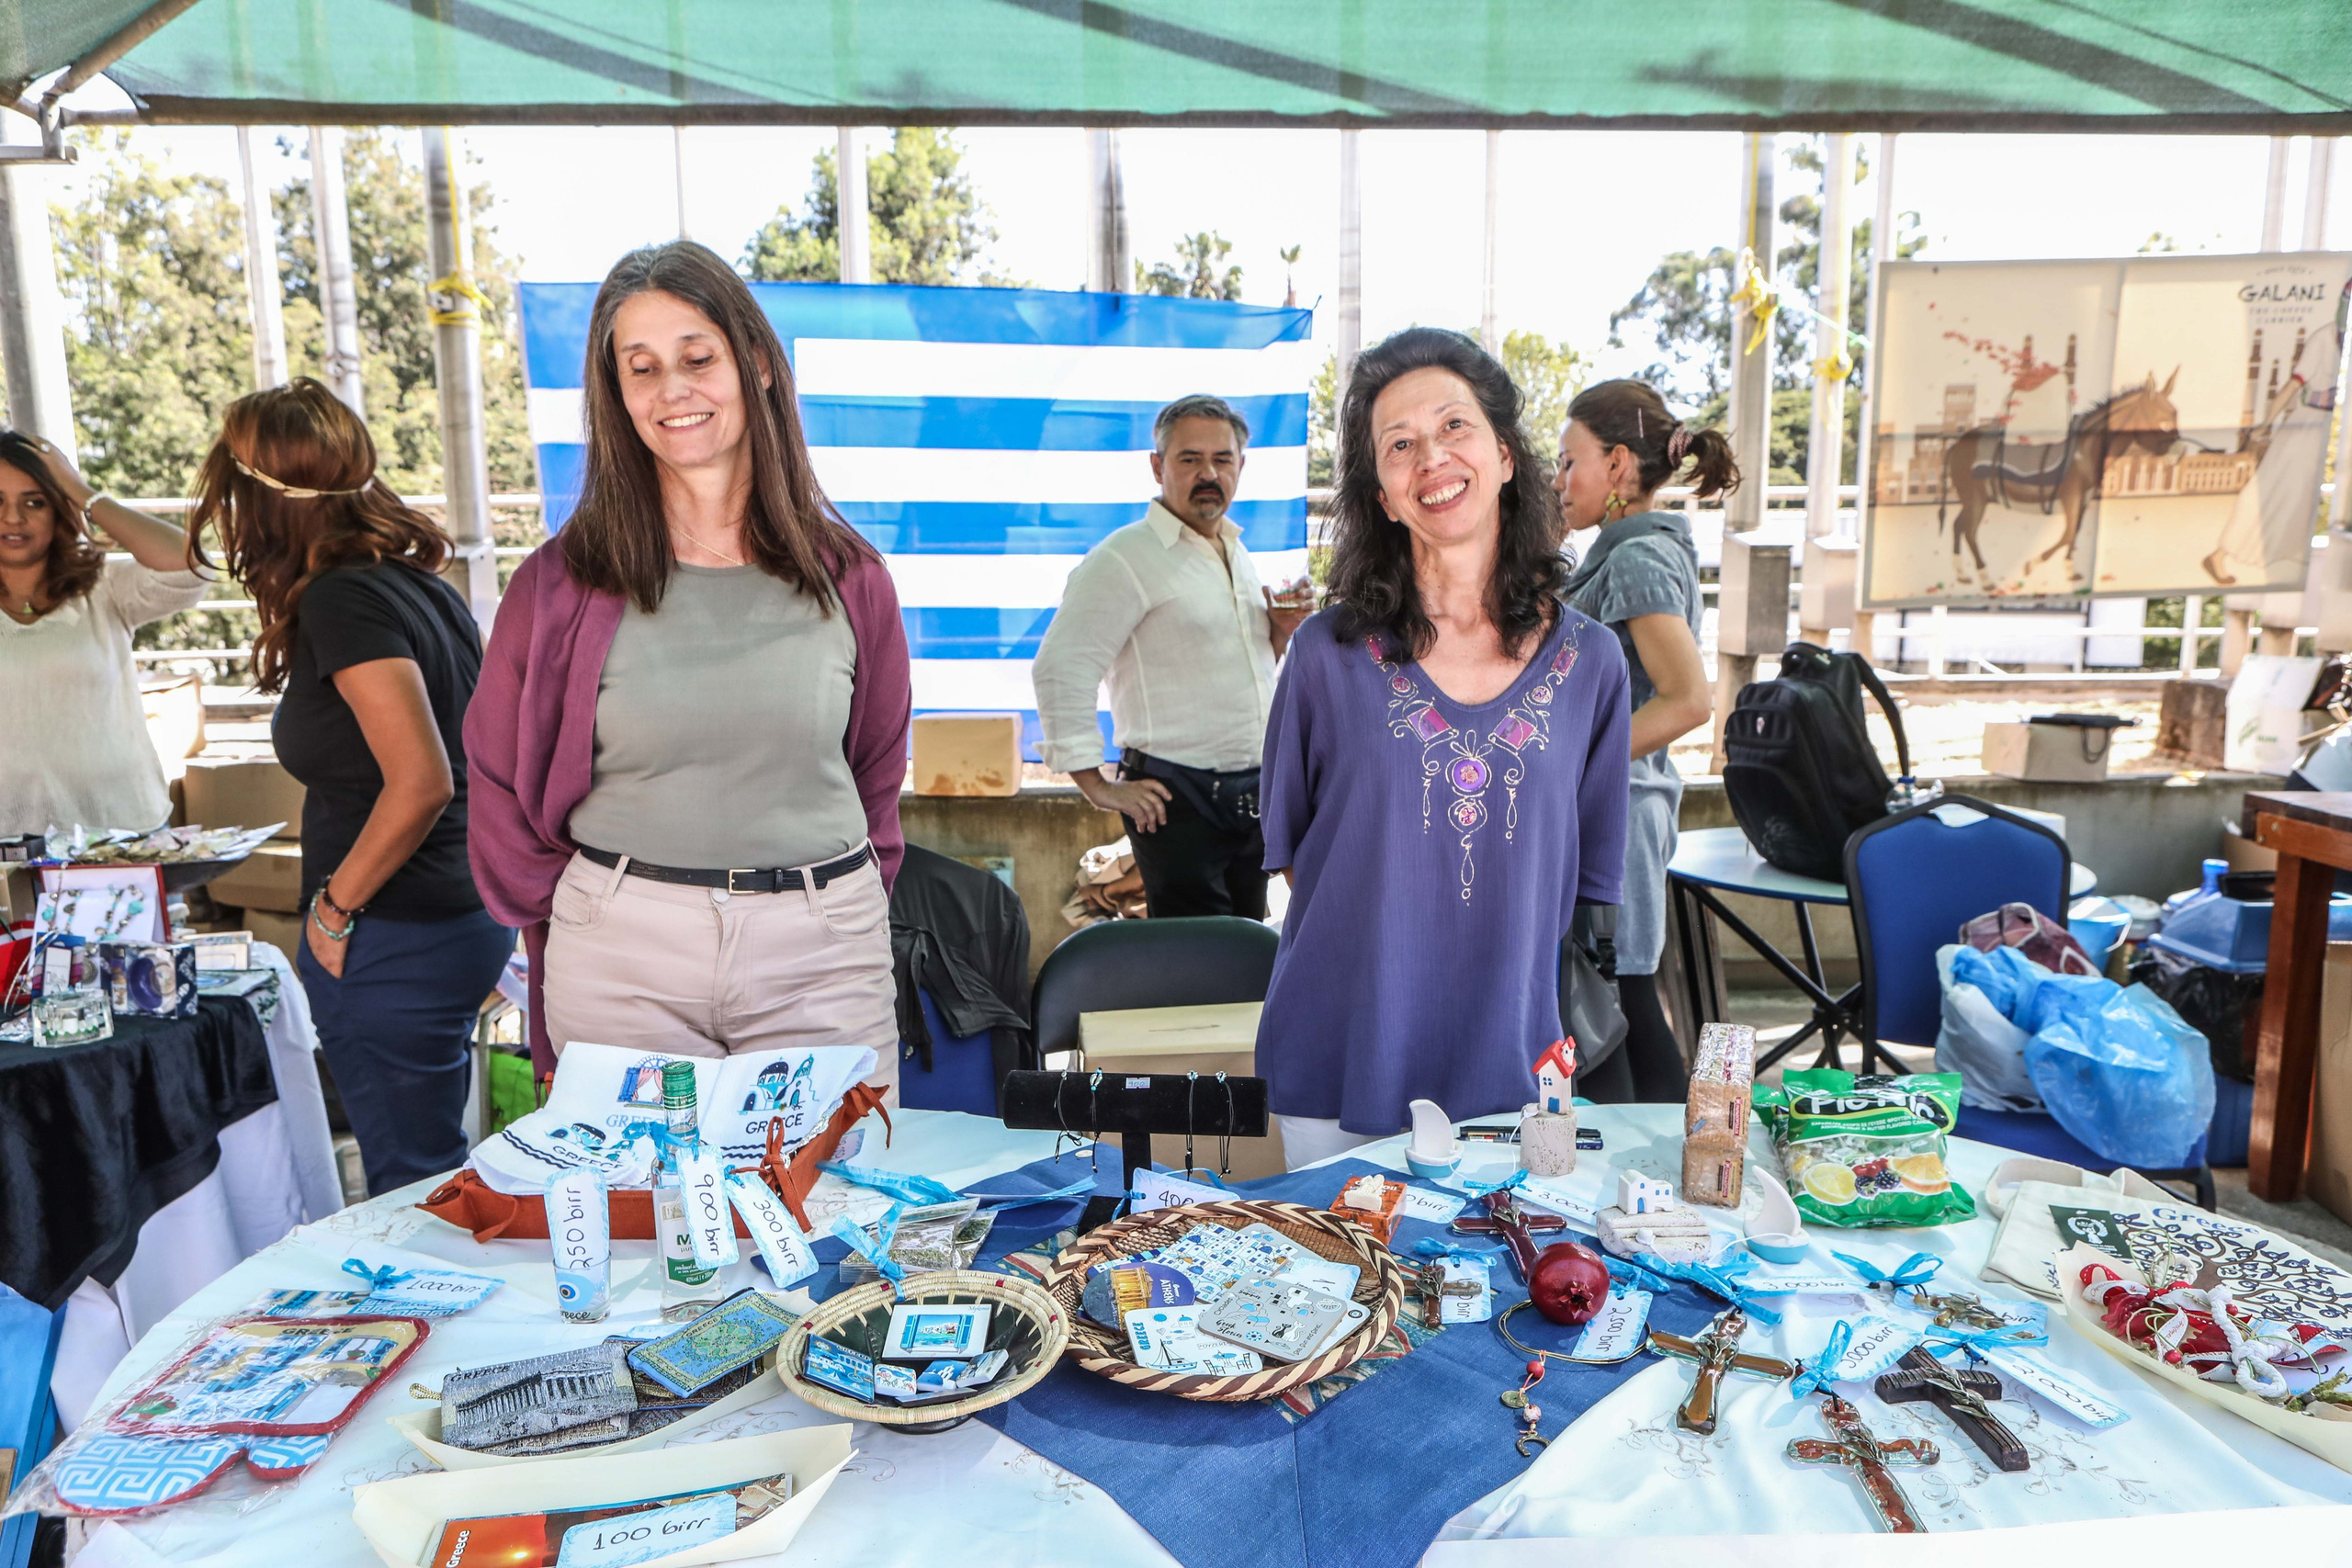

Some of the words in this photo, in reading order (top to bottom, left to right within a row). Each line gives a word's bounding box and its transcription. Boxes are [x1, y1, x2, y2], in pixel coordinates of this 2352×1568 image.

[2238, 283, 2325, 302] GALANI
[745, 1112, 805, 1134] GRCE
[563, 1187, 584, 1223] birr
[694, 1173, 718, 1222] 900
[1417, 1197, 1449, 1211] birr
[2152, 1207, 2260, 1235] Greece
[705, 1227, 721, 1257] birr
[752, 1200, 783, 1234] 300
[776, 1236, 799, 1268] birr
[450, 1283, 481, 1293] birr
[1159, 1279, 1175, 1304] ATHENS
[560, 1306, 591, 1321] reece
[1456, 1302, 1476, 1318] birr
[2001, 1312, 2037, 1323] birr
[685, 1316, 719, 1337] GREECE
[1216, 1319, 1237, 1329] Greek
[1132, 1322, 1151, 1350] GREECE
[1596, 1335, 1622, 1352] birr
[1867, 1325, 1894, 1343] birr
[835, 1345, 872, 1361] GREECE
[450, 1365, 511, 1382] GREECE
[2082, 1404, 2114, 1422] birr
[593, 1526, 651, 1551] 100
[662, 1516, 711, 1536] birr
[446, 1529, 471, 1568] Greece
